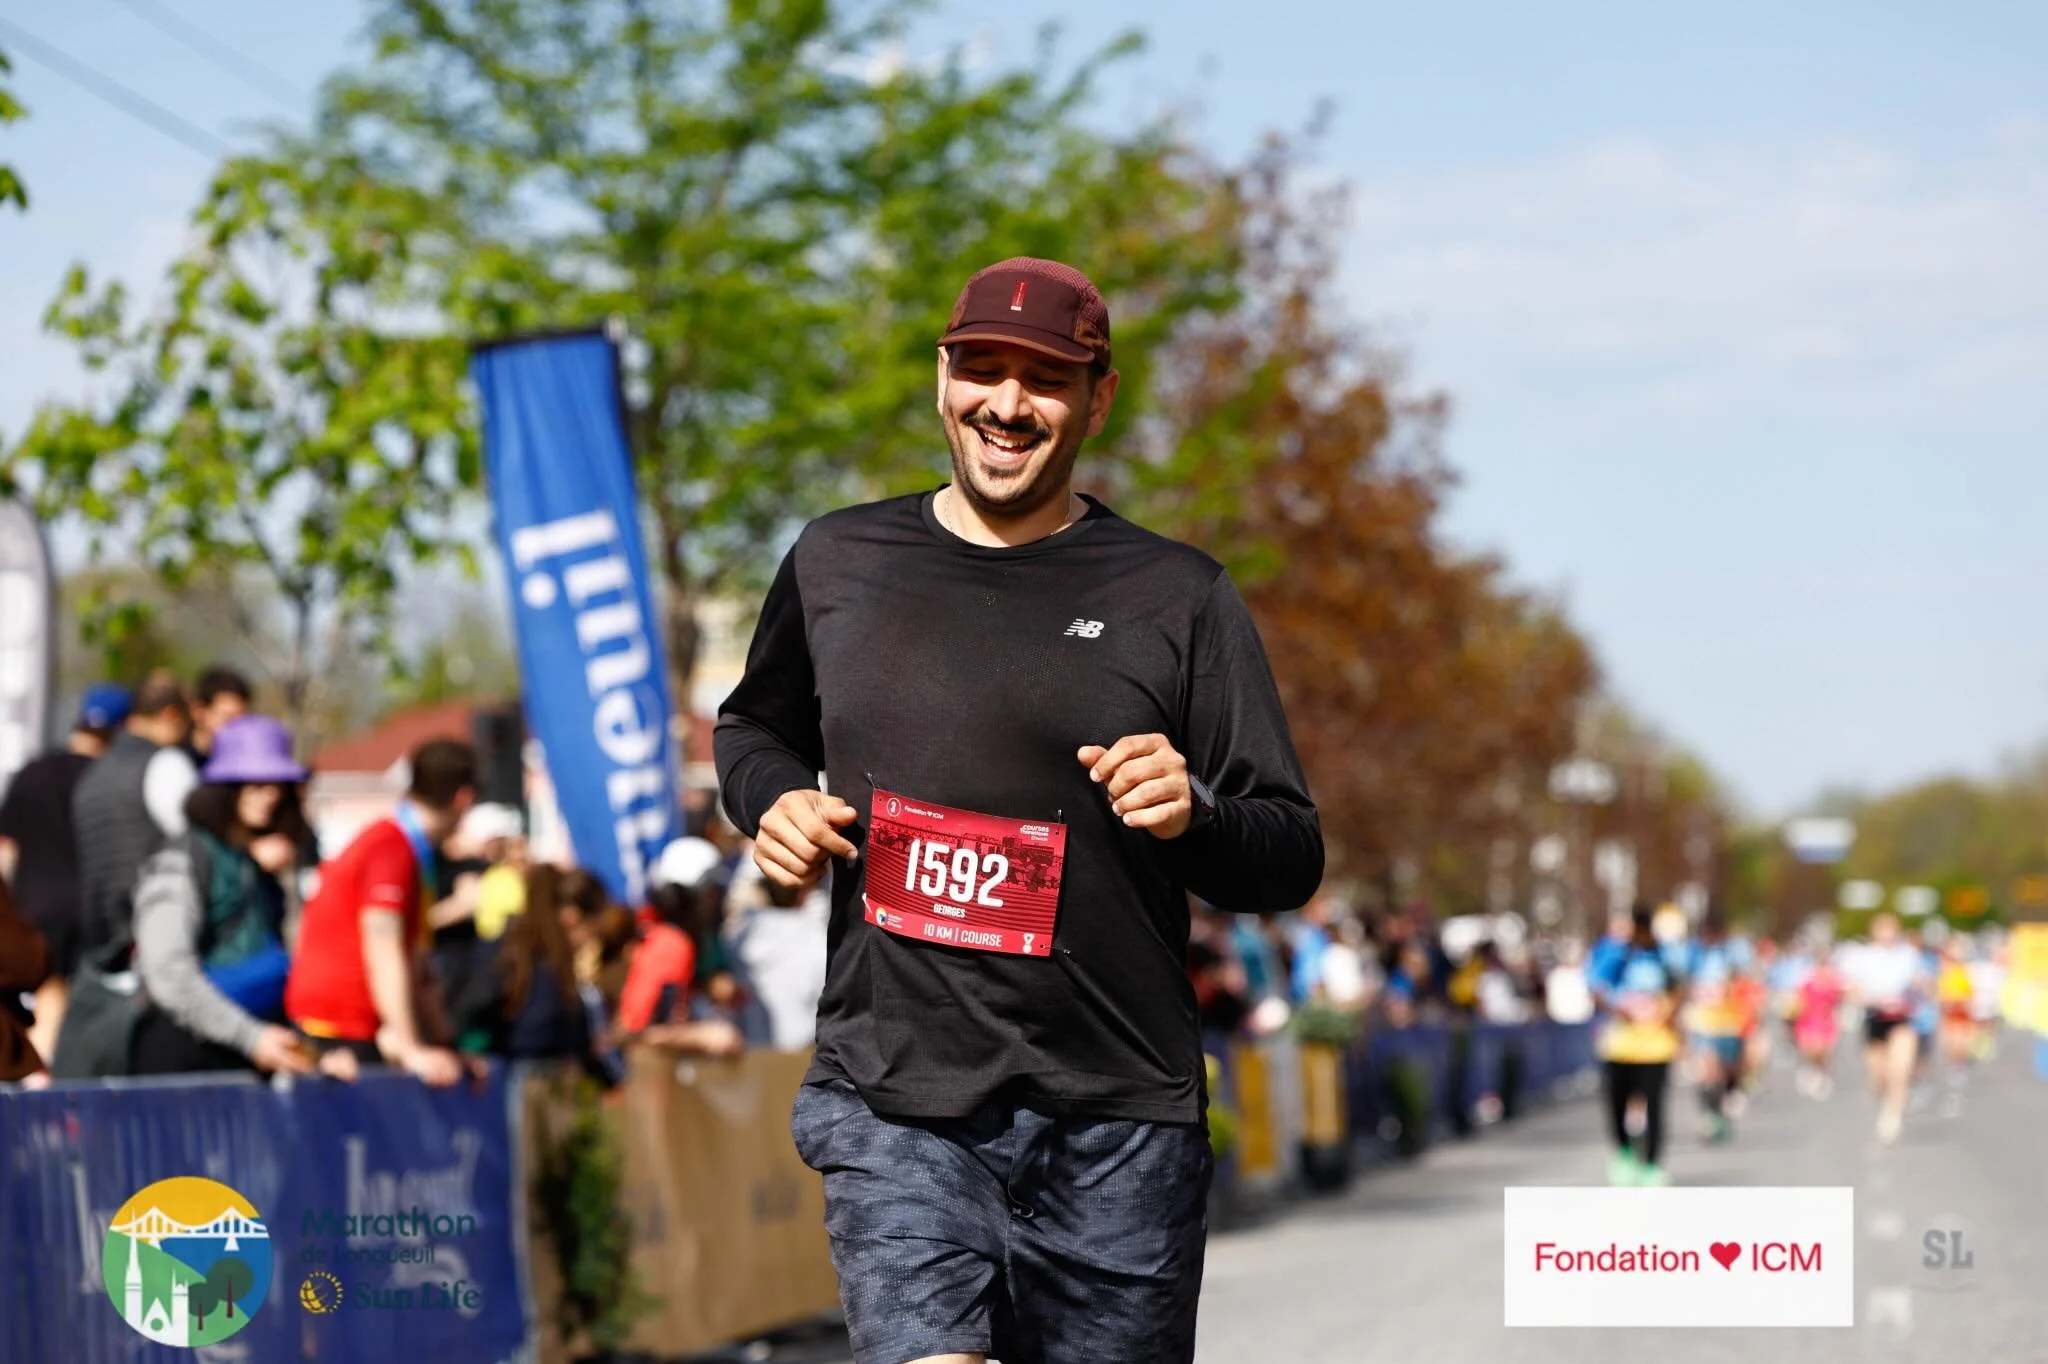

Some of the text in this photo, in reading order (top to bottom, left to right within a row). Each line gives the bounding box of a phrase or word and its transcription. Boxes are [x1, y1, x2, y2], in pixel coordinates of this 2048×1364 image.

[905, 838, 1009, 907] 1592
[933, 903, 966, 918] GEORGES
[923, 923, 1003, 947] 10 KM COURSE
